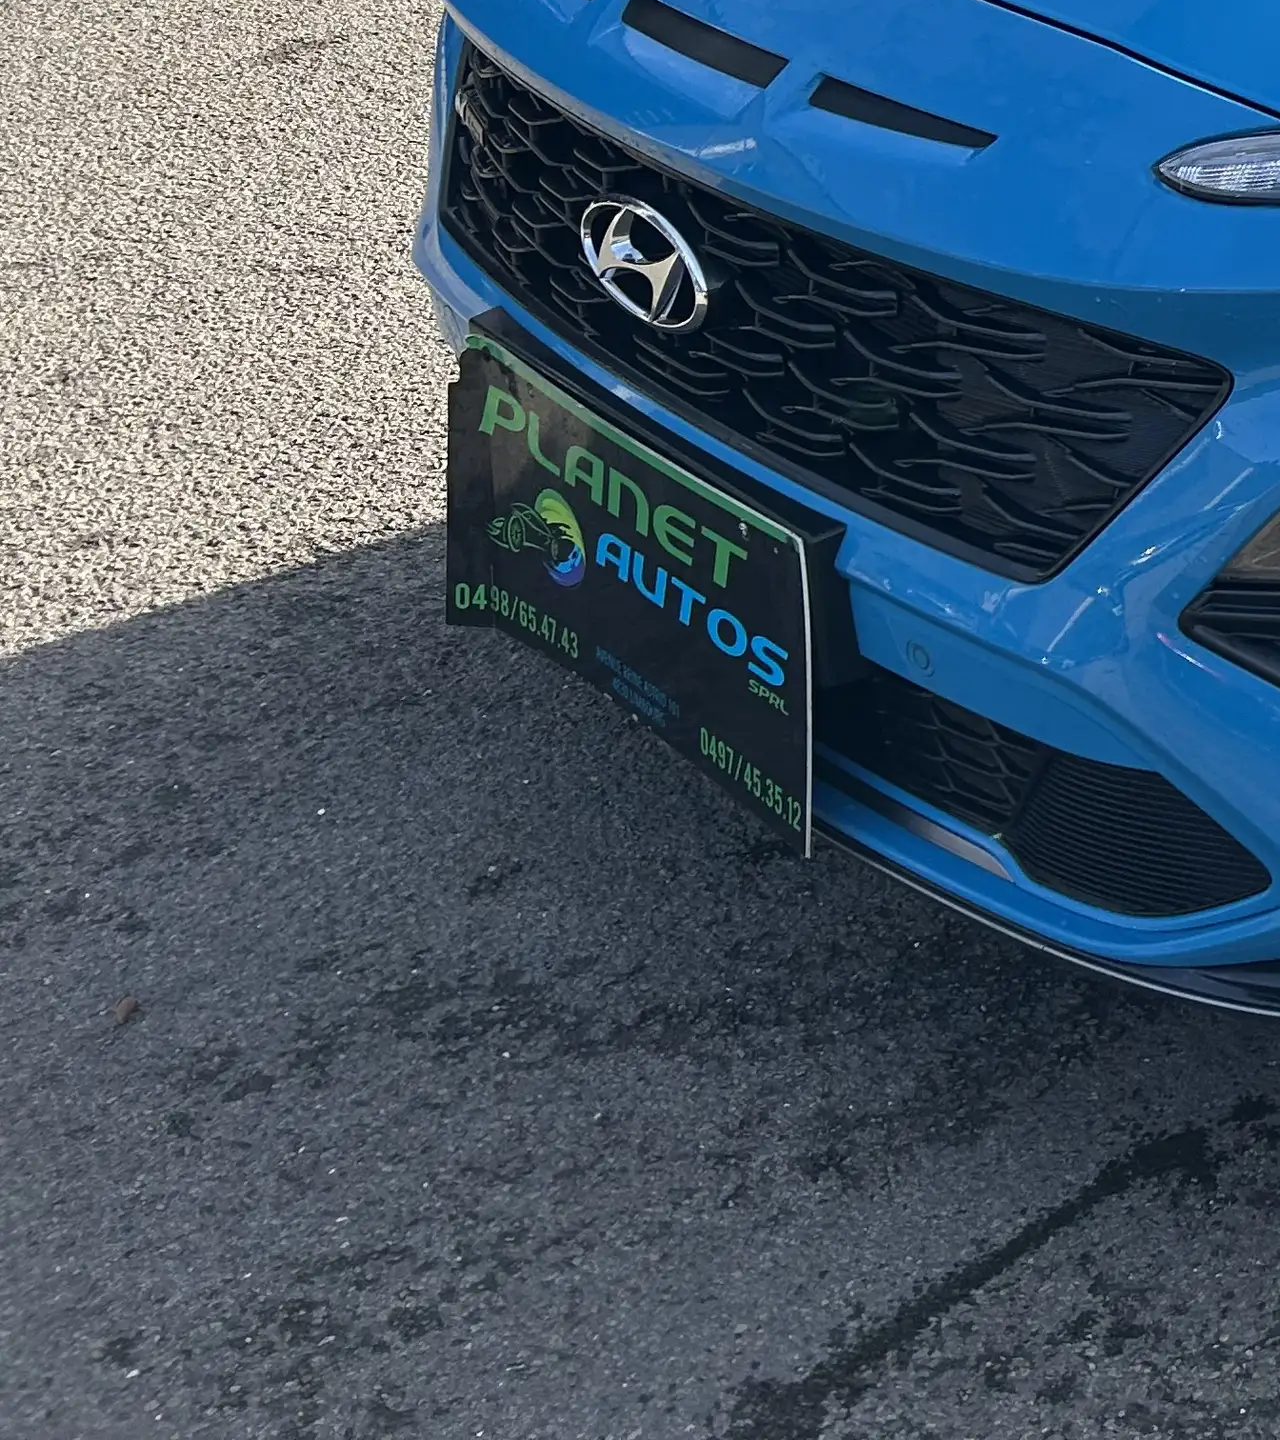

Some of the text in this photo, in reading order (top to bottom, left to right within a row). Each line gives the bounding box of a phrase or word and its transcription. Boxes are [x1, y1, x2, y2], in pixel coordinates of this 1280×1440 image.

[479, 384, 748, 589] PLANET
[455, 583, 580, 659] 0498/65.47.43
[595, 532, 789, 687] AUTOS
[748, 678, 789, 716] SPRL
[700, 726, 802, 832] 0497/45.35.12
